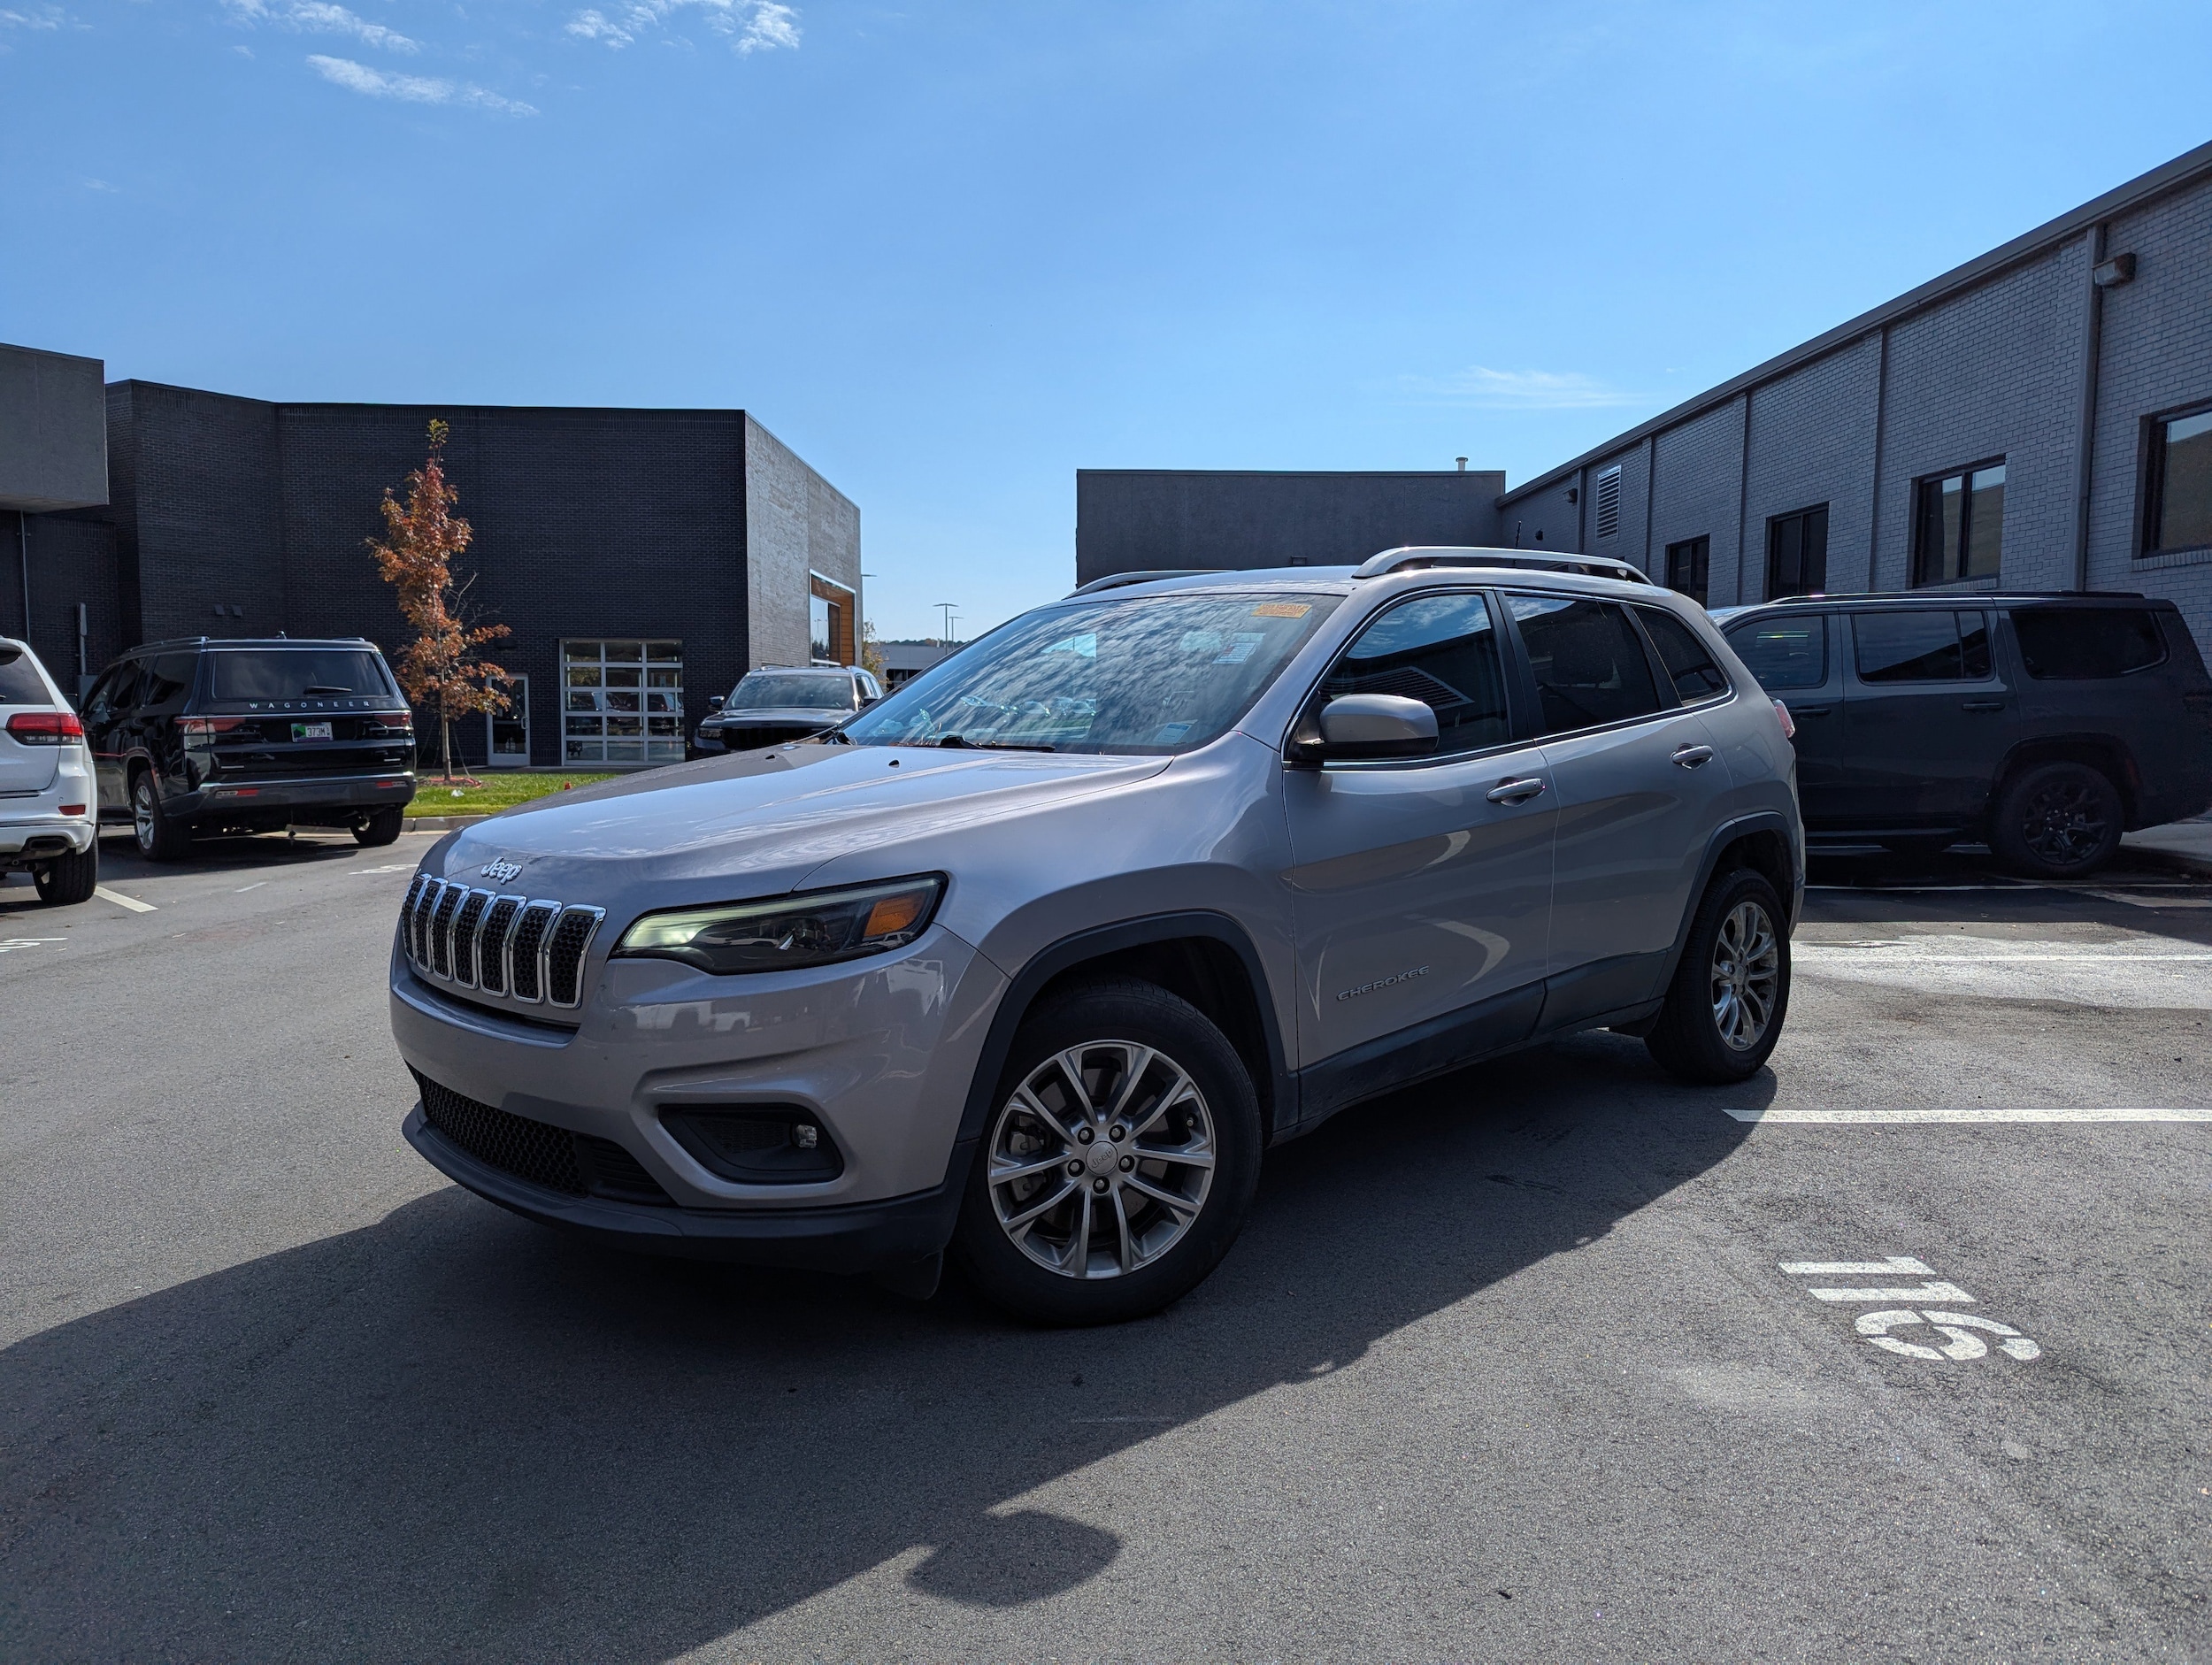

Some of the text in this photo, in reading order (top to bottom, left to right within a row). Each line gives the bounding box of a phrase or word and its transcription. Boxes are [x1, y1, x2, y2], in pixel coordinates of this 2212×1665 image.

[480, 856, 522, 885] Jeep
[1337, 965, 1430, 1001] CHEROKEE
[1092, 1148, 1113, 1168] Jeep
[1778, 1256, 2040, 1361] 116
